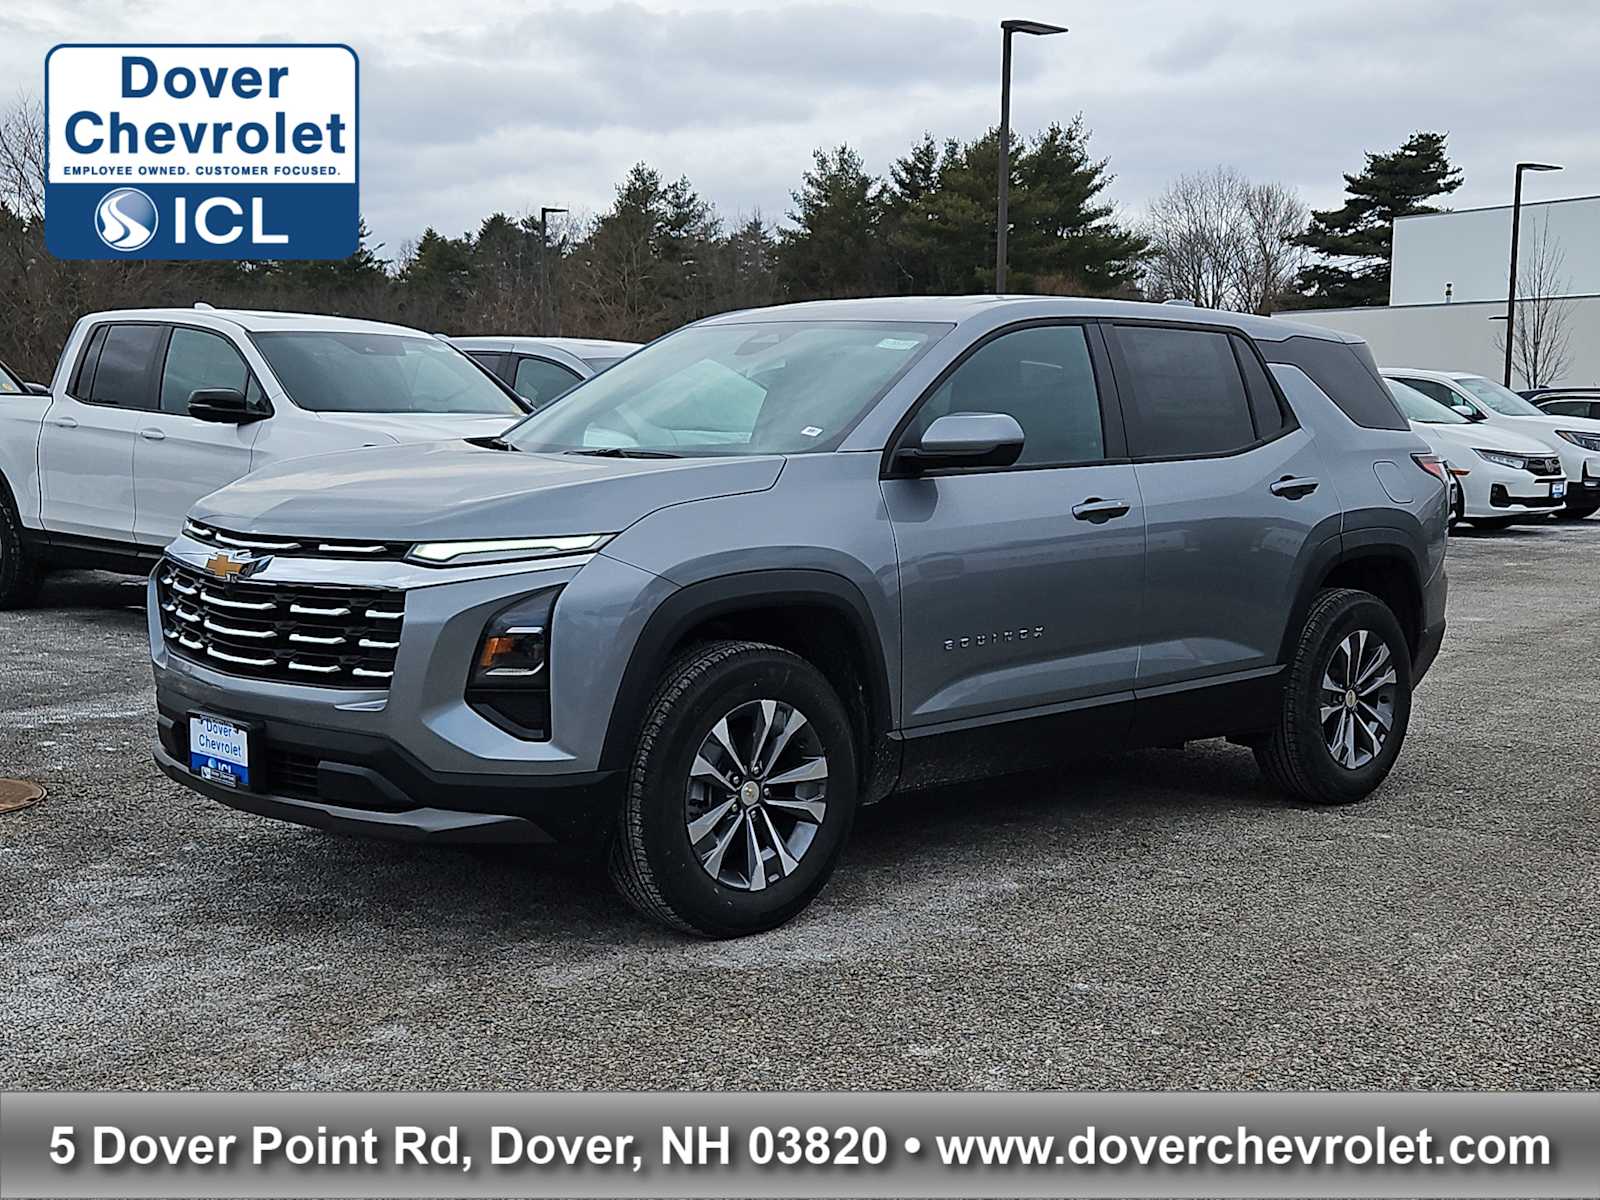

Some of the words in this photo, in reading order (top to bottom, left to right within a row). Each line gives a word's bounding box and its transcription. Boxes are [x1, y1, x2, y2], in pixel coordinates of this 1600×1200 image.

[943, 625, 1044, 650] EQUINOX
[206, 719, 232, 737] Dover
[199, 734, 241, 757] Chevrolet
